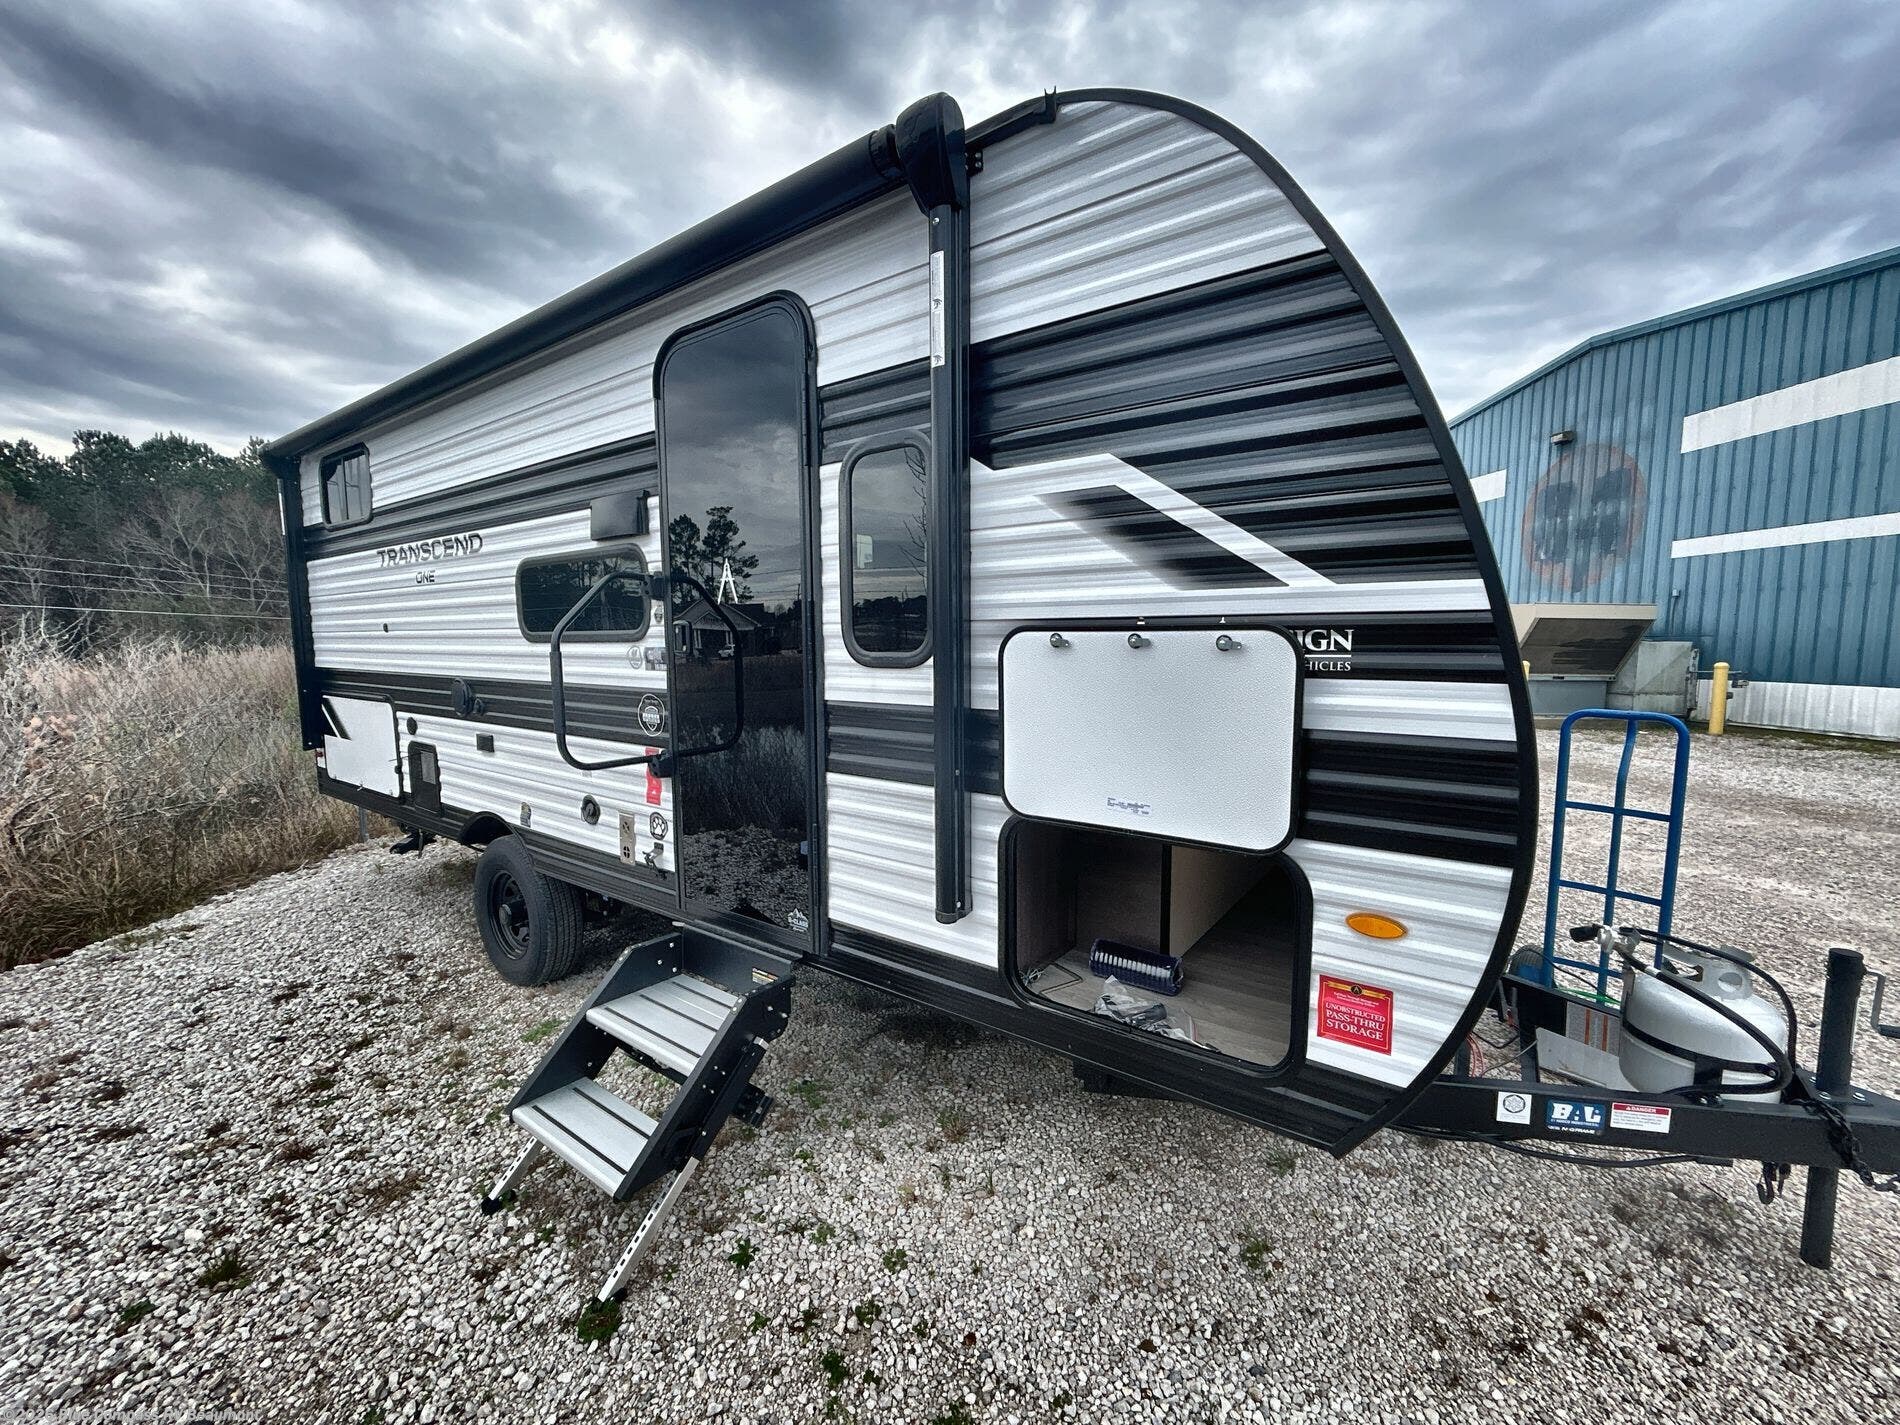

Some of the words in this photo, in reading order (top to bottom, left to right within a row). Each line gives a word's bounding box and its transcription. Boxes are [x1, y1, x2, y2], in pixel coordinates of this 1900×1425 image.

[377, 533, 483, 568] TRANSCEND
[415, 570, 436, 584] ONE
[1289, 629, 1354, 651] IGN
[1325, 1002, 1386, 1022] UNOBSTRUCTED
[1326, 1009, 1385, 1031] PASS-THRU
[1326, 1018, 1384, 1041] STORAGE
[1551, 1102, 1601, 1123] BAL
[1631, 1106, 1656, 1114] DANGER
